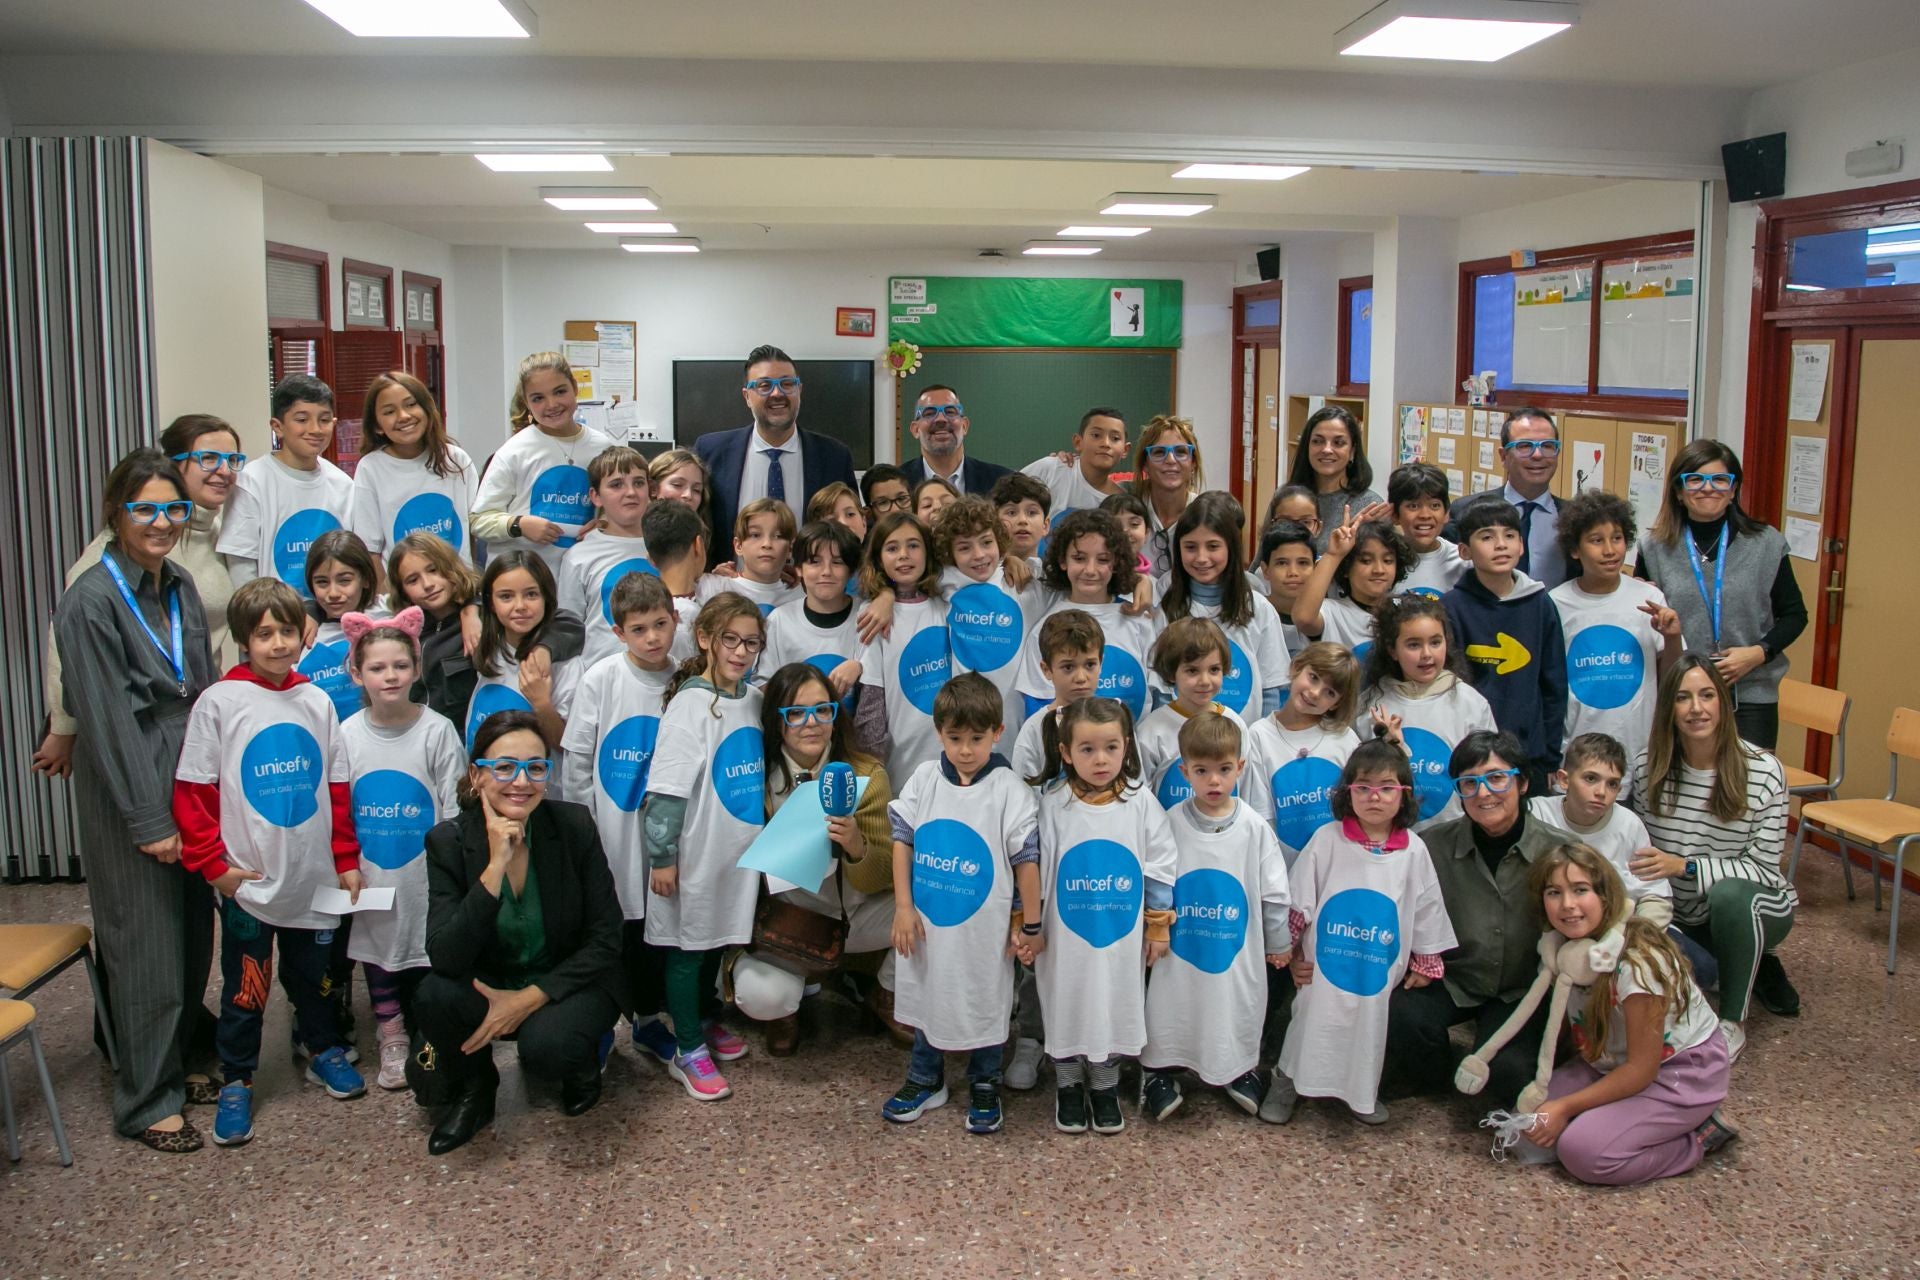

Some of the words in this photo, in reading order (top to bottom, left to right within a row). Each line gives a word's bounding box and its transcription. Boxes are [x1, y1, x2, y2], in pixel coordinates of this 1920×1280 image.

[542, 490, 580, 505] unicef
[954, 609, 995, 626] unicef
[1575, 651, 1617, 668] unicef
[254, 755, 301, 777] unicef
[1277, 785, 1322, 809] unicef
[358, 801, 400, 818] unicef
[915, 851, 959, 873] unicef
[1066, 874, 1113, 892] unicef
[1175, 902, 1223, 920] unicef
[1326, 921, 1378, 943] unicef
